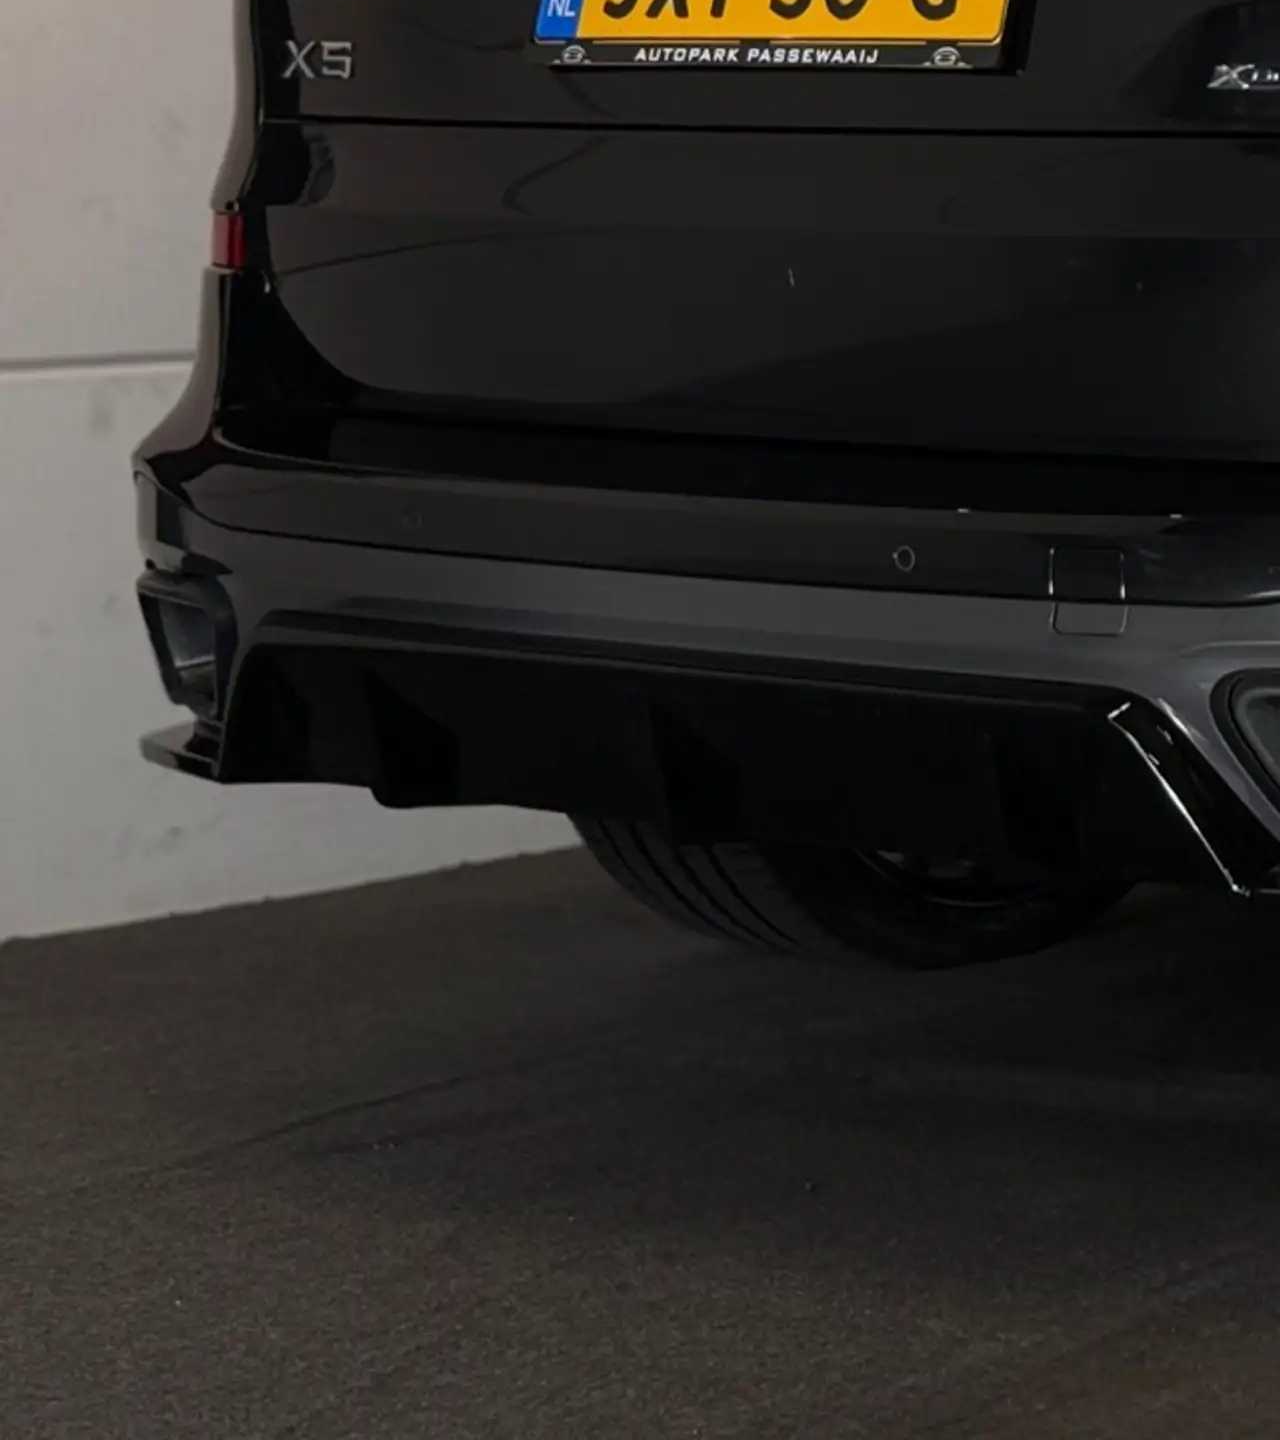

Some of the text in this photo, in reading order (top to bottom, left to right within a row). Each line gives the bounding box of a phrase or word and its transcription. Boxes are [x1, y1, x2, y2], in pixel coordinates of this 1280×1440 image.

[283, 40, 352, 79] X5
[634, 47, 879, 65] AUTOPARK PASSEWAAIJ
